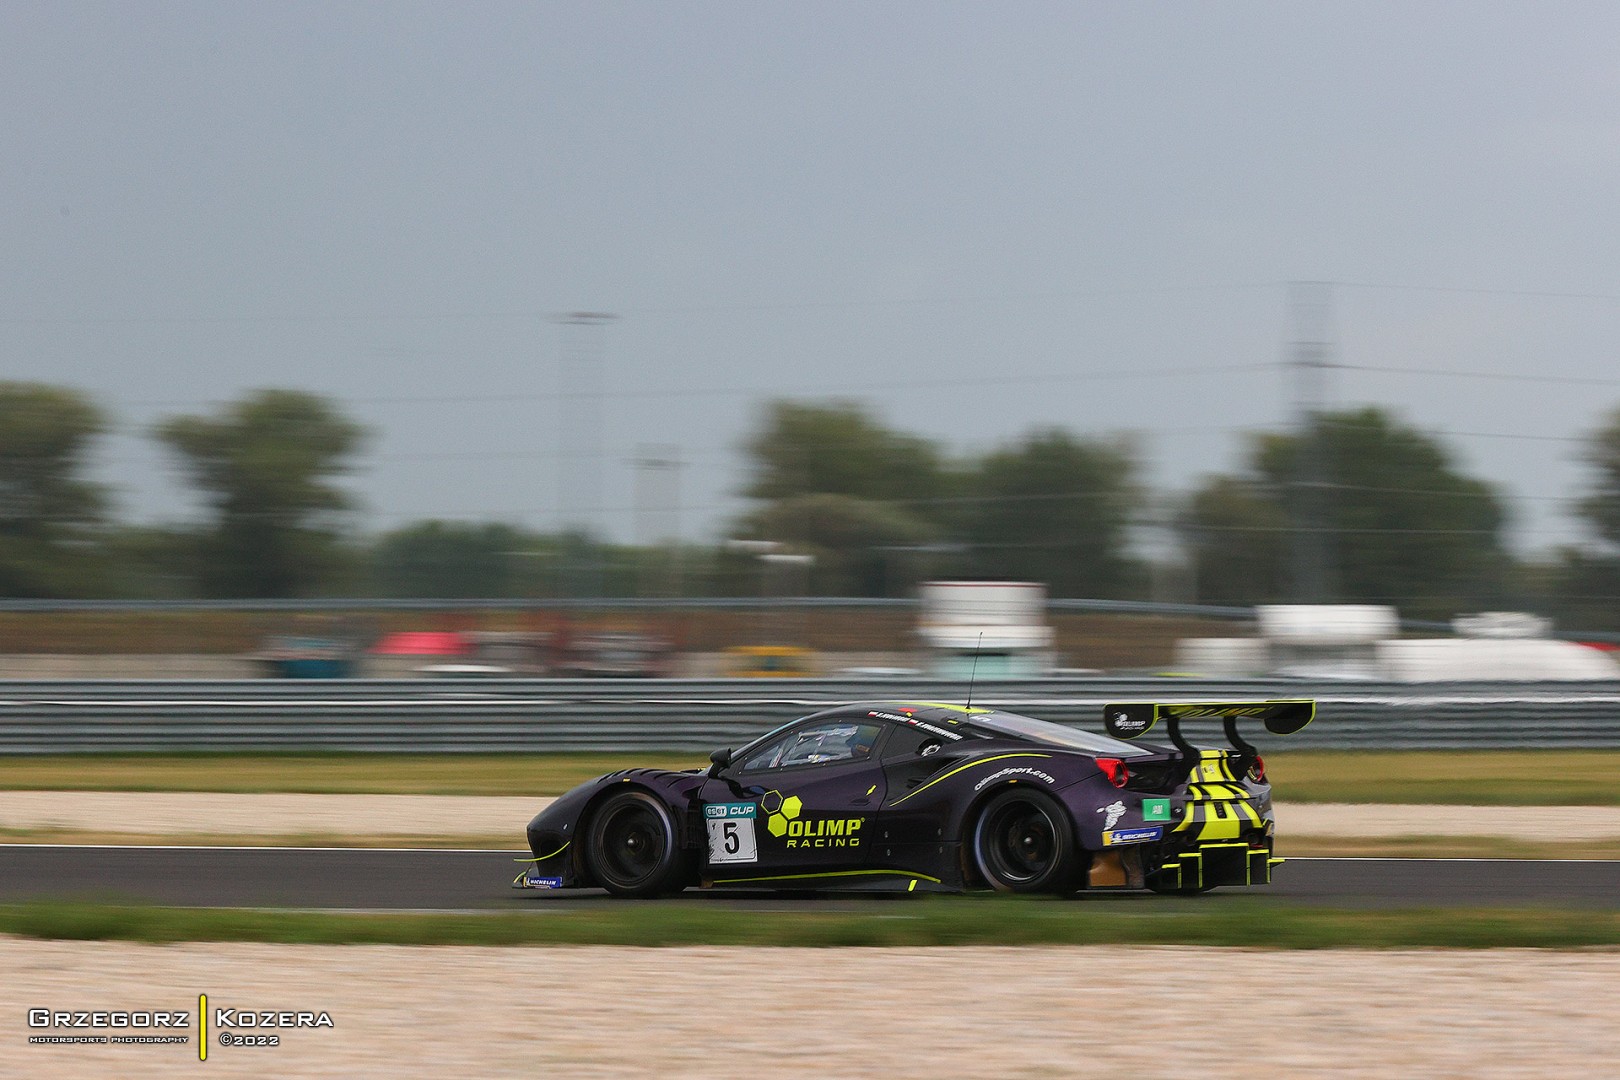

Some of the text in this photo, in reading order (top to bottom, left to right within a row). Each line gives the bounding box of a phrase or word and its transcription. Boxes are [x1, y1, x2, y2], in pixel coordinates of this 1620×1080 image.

[730, 806, 754, 815] CUP
[723, 822, 740, 854] 5
[786, 838, 860, 848] RACING
